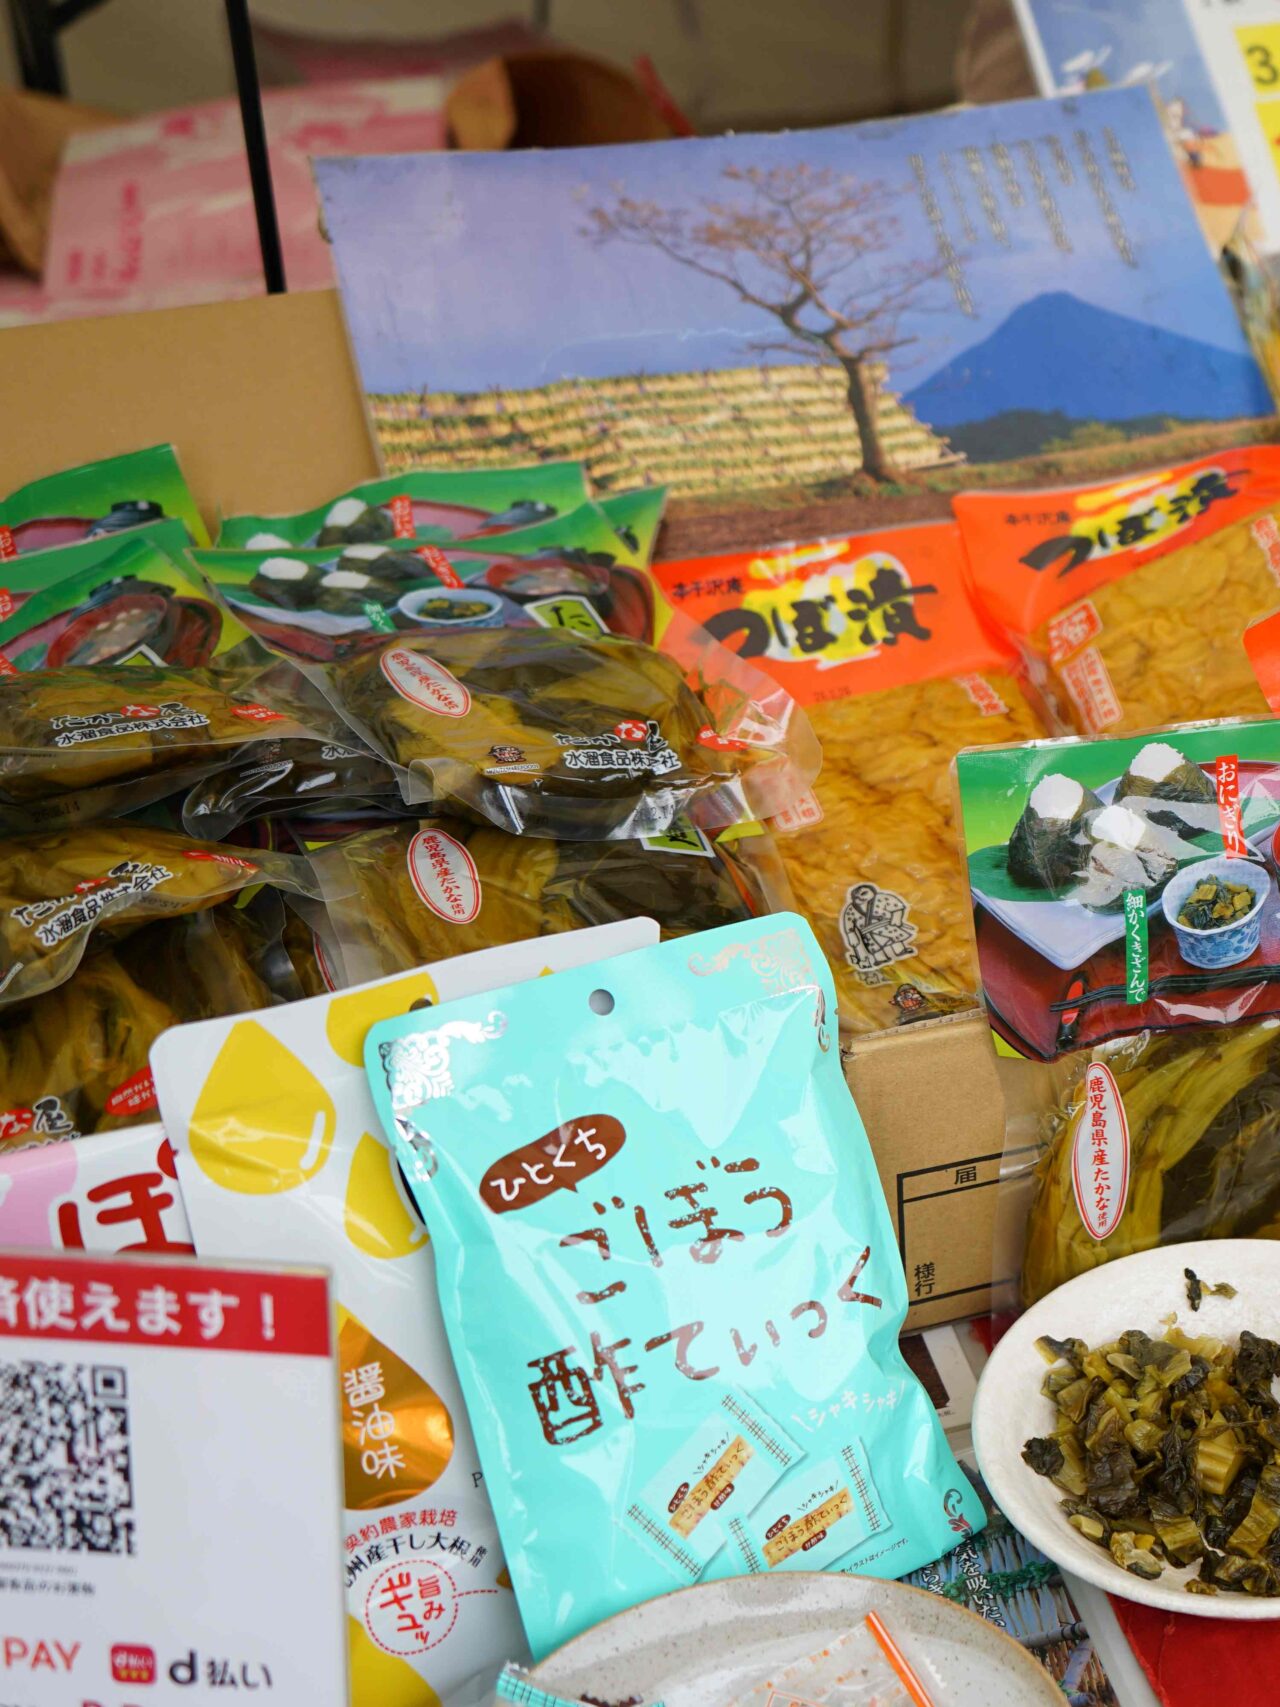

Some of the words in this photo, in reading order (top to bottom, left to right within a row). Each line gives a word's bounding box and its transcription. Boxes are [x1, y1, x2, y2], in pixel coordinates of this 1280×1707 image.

[1217, 762, 1242, 855] おにぎり
[1125, 892, 1147, 1003] 細かくきざんで
[490, 1127, 608, 1201] ひとくち
[3, 1637, 81, 1672] PAY
